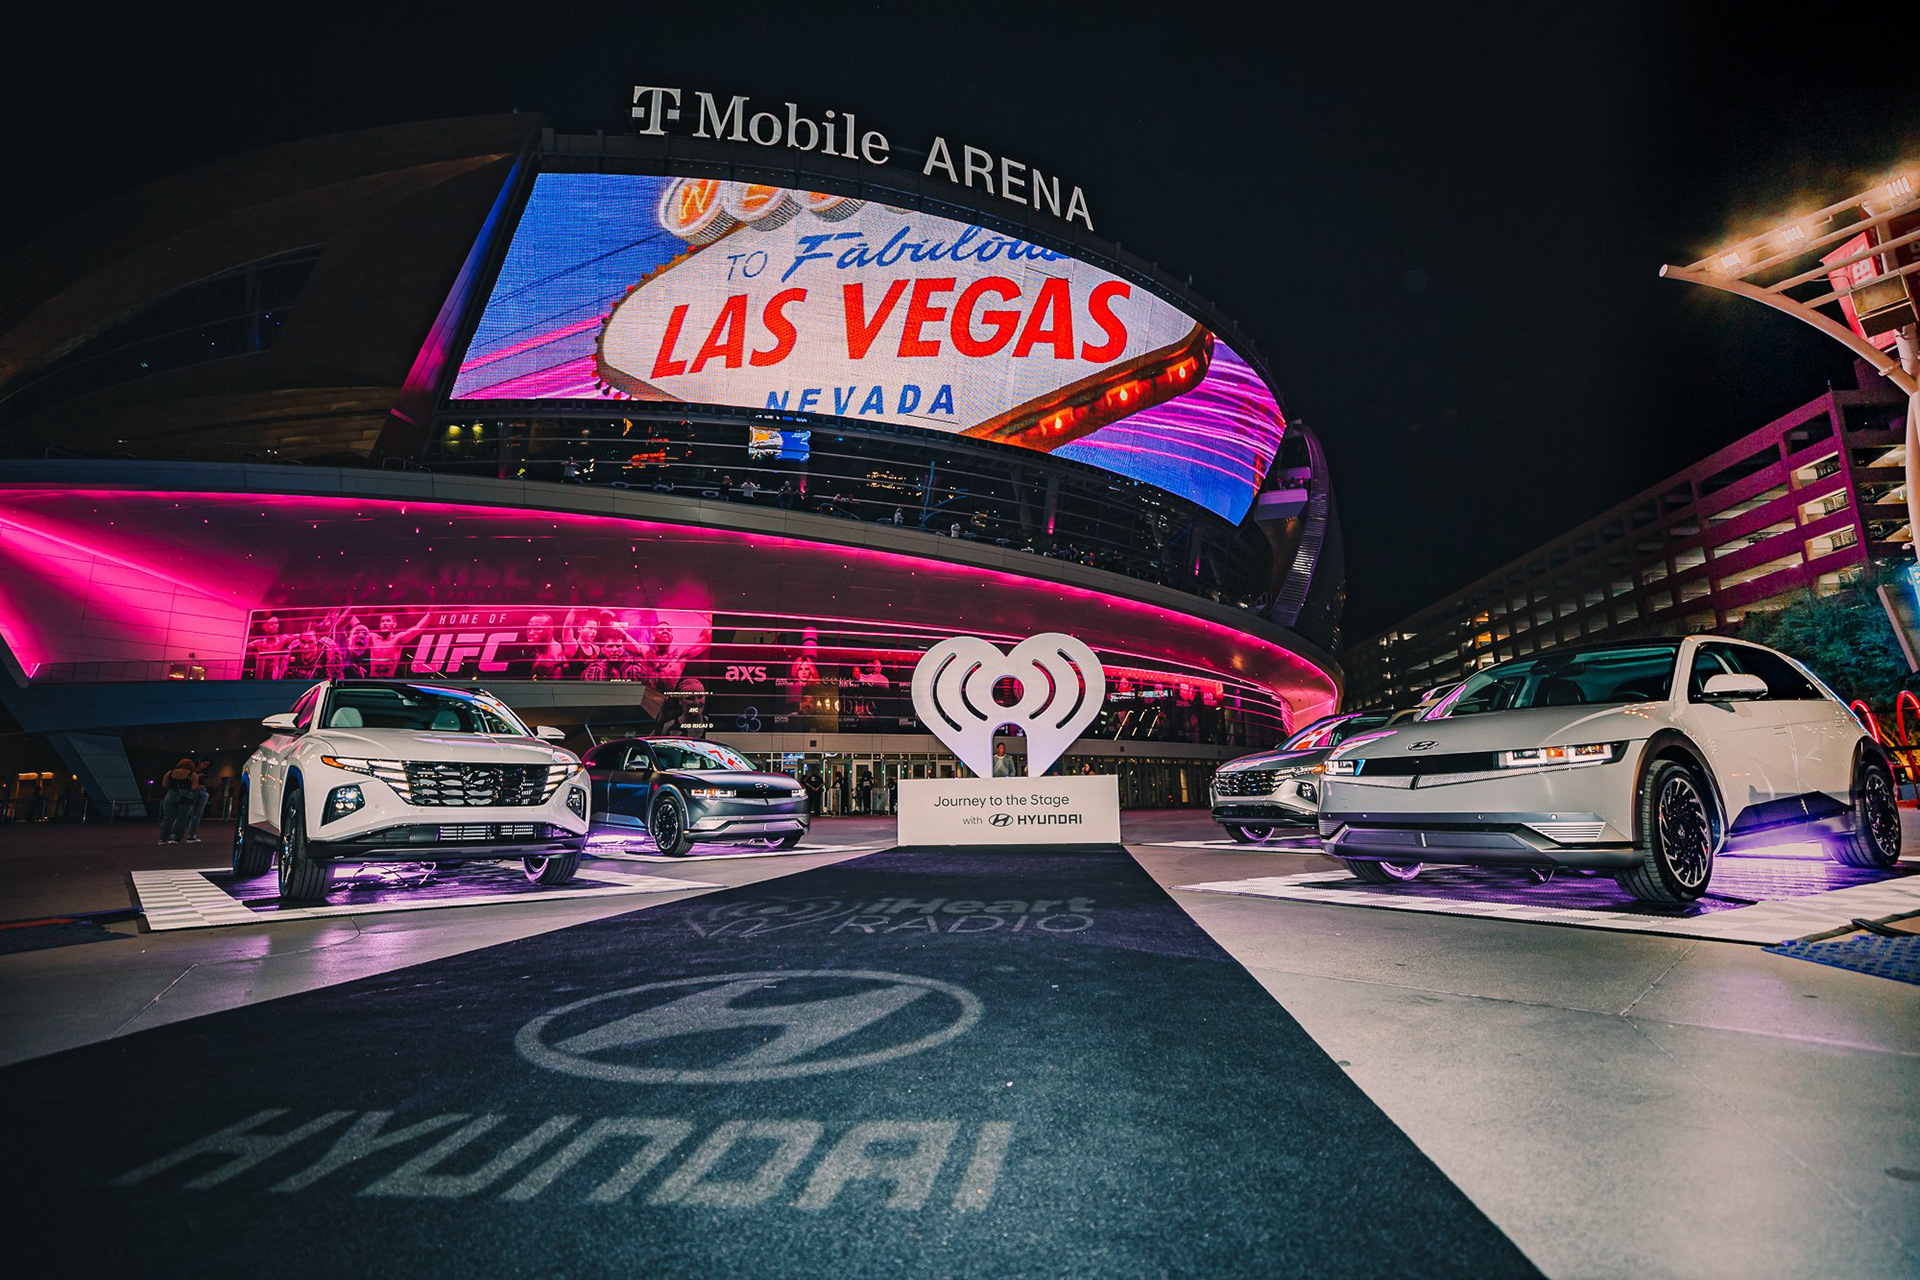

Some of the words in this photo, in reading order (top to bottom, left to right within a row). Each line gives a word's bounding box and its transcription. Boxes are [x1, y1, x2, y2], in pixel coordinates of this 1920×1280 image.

[923, 136, 1095, 232] ARENA
[727, 250, 769, 281] TO
[650, 288, 808, 379] LAS
[842, 276, 1131, 364] VEGAS
[765, 384, 955, 417] NEVADA
[440, 614, 484, 625] HOME
[490, 613, 507, 624] OF
[411, 632, 518, 674] UFC
[725, 665, 767, 684] axs
[934, 796, 987, 809] Journey
[989, 796, 1003, 806] to
[1006, 795, 1027, 806] the
[1030, 794, 1070, 808] Stage
[962, 816, 983, 825] with
[1017, 814, 1082, 825] HYUNDAI
[865, 896, 1096, 914] iHeart
[830, 914, 1095, 934] RADIO
[111, 1106, 1015, 1213] HYUNDAI
